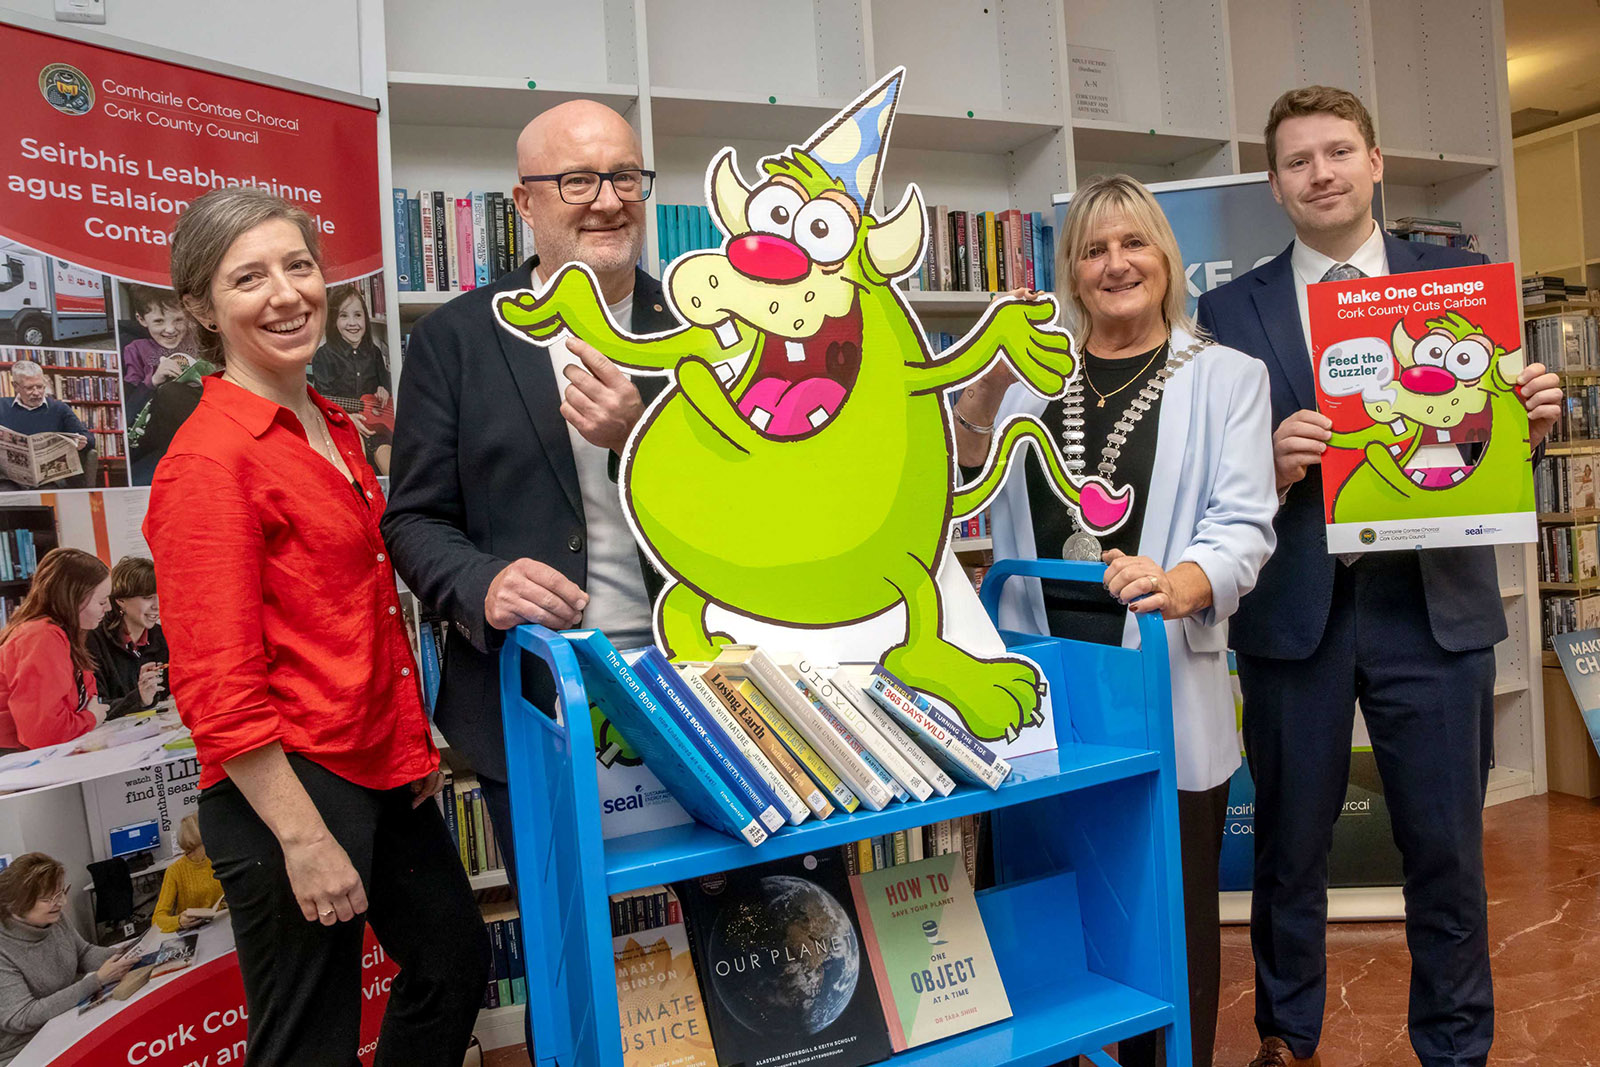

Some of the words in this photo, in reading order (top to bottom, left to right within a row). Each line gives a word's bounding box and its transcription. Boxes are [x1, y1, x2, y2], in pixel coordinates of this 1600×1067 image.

[102, 79, 183, 107] Comhairle
[187, 97, 242, 120] Contae
[245, 108, 300, 131] Chorcaí
[104, 103, 142, 123] Cork
[147, 111, 202, 136] County
[206, 123, 259, 145] Council
[20, 138, 140, 176] Seirbhís
[8, 174, 83, 201] agus
[1184, 260, 1233, 298] KE
[1337, 288, 1381, 305] Make
[1384, 285, 1417, 301] One
[1421, 279, 1485, 298] Change
[1337, 305, 1365, 319] Cork
[1368, 303, 1410, 318] County
[1413, 299, 1440, 312] Cuts
[1443, 295, 1487, 309] Carbon
[1327, 355, 1360, 367] Feed
[1362, 352, 1384, 365] the
[1328, 365, 1378, 379] Guzzler
[1464, 525, 1483, 536] seai
[879, 672, 893, 686] LUCY
[1576, 658, 1600, 675] CH
[606, 650, 620, 668] The
[618, 666, 640, 693] Ocean
[638, 690, 657, 714] Book
[656, 673, 669, 691] THE
[667, 687, 693, 719] CLIMATE
[690, 716, 707, 738] BOOK
[690, 675, 716, 708] WORKING
[715, 706, 729, 722] WITH
[727, 719, 749, 747] NATURE
[710, 673, 742, 712] Losing
[738, 707, 766, 741] Earth
[799, 660, 866, 734] CHOKED
[749, 690, 763, 705] HOW
[760, 703, 769, 714] TO
[766, 708, 780, 727] GIVE
[778, 721, 786, 733] UP
[783, 729, 807, 755] PLASTIC
[884, 688, 902, 706] 365
[901, 702, 924, 724] DAYS
[923, 719, 945, 741] WILD
[830, 718, 847, 739] FIGHT
[844, 734, 862, 756] PLASTIC
[872, 708, 885, 728] living
[886, 723, 909, 748] without
[906, 745, 927, 766] plastic
[934, 712, 960, 735] TURNING
[961, 733, 973, 745] THE
[973, 743, 987, 757] TIDE
[752, 753, 770, 775] JEREMY
[768, 743, 792, 771] Nathaniel
[807, 753, 818, 765] WILL
[812, 719, 824, 732] THE
[822, 727, 860, 773] UNINHABITABLE
[859, 771, 871, 785] EAR
[951, 743, 965, 757] LUCY
[125, 775, 151, 787] watch
[167, 780, 200, 796] searc
[722, 758, 739, 780] GRETA
[738, 776, 765, 809] THUNBERG
[878, 770, 891, 784] DORE
[126, 787, 155, 804] find
[154, 765, 172, 832] synthesize
[603, 785, 644, 814] seai
[1230, 823, 1254, 835] Cou
[885, 877, 922, 906] HOW
[926, 873, 949, 895] TO
[891, 907, 909, 918] SAVE
[910, 903, 928, 913] YOUR
[930, 897, 955, 909] PLANET
[618, 961, 656, 978] MARY
[715, 953, 761, 976] OUR
[771, 934, 852, 965] PLANET
[930, 952, 946, 962] ONE
[617, 969, 678, 991] BINSON
[910, 957, 976, 994] OBJECT
[933, 996, 942, 1004] AT
[952, 988, 969, 999] TIME
[203, 1005, 248, 1034] Cou
[620, 995, 696, 1028] IMATE
[127, 1024, 197, 1065] Cork
[622, 1019, 700, 1054] USTICE
[756, 1055, 781, 1066] ALASTAIR
[782, 1047, 813, 1059] FOTHERGILL
[818, 1041, 834, 1050] KEITH
[834, 1036, 857, 1047] SCHOLEY
[217, 1040, 247, 1065] an
